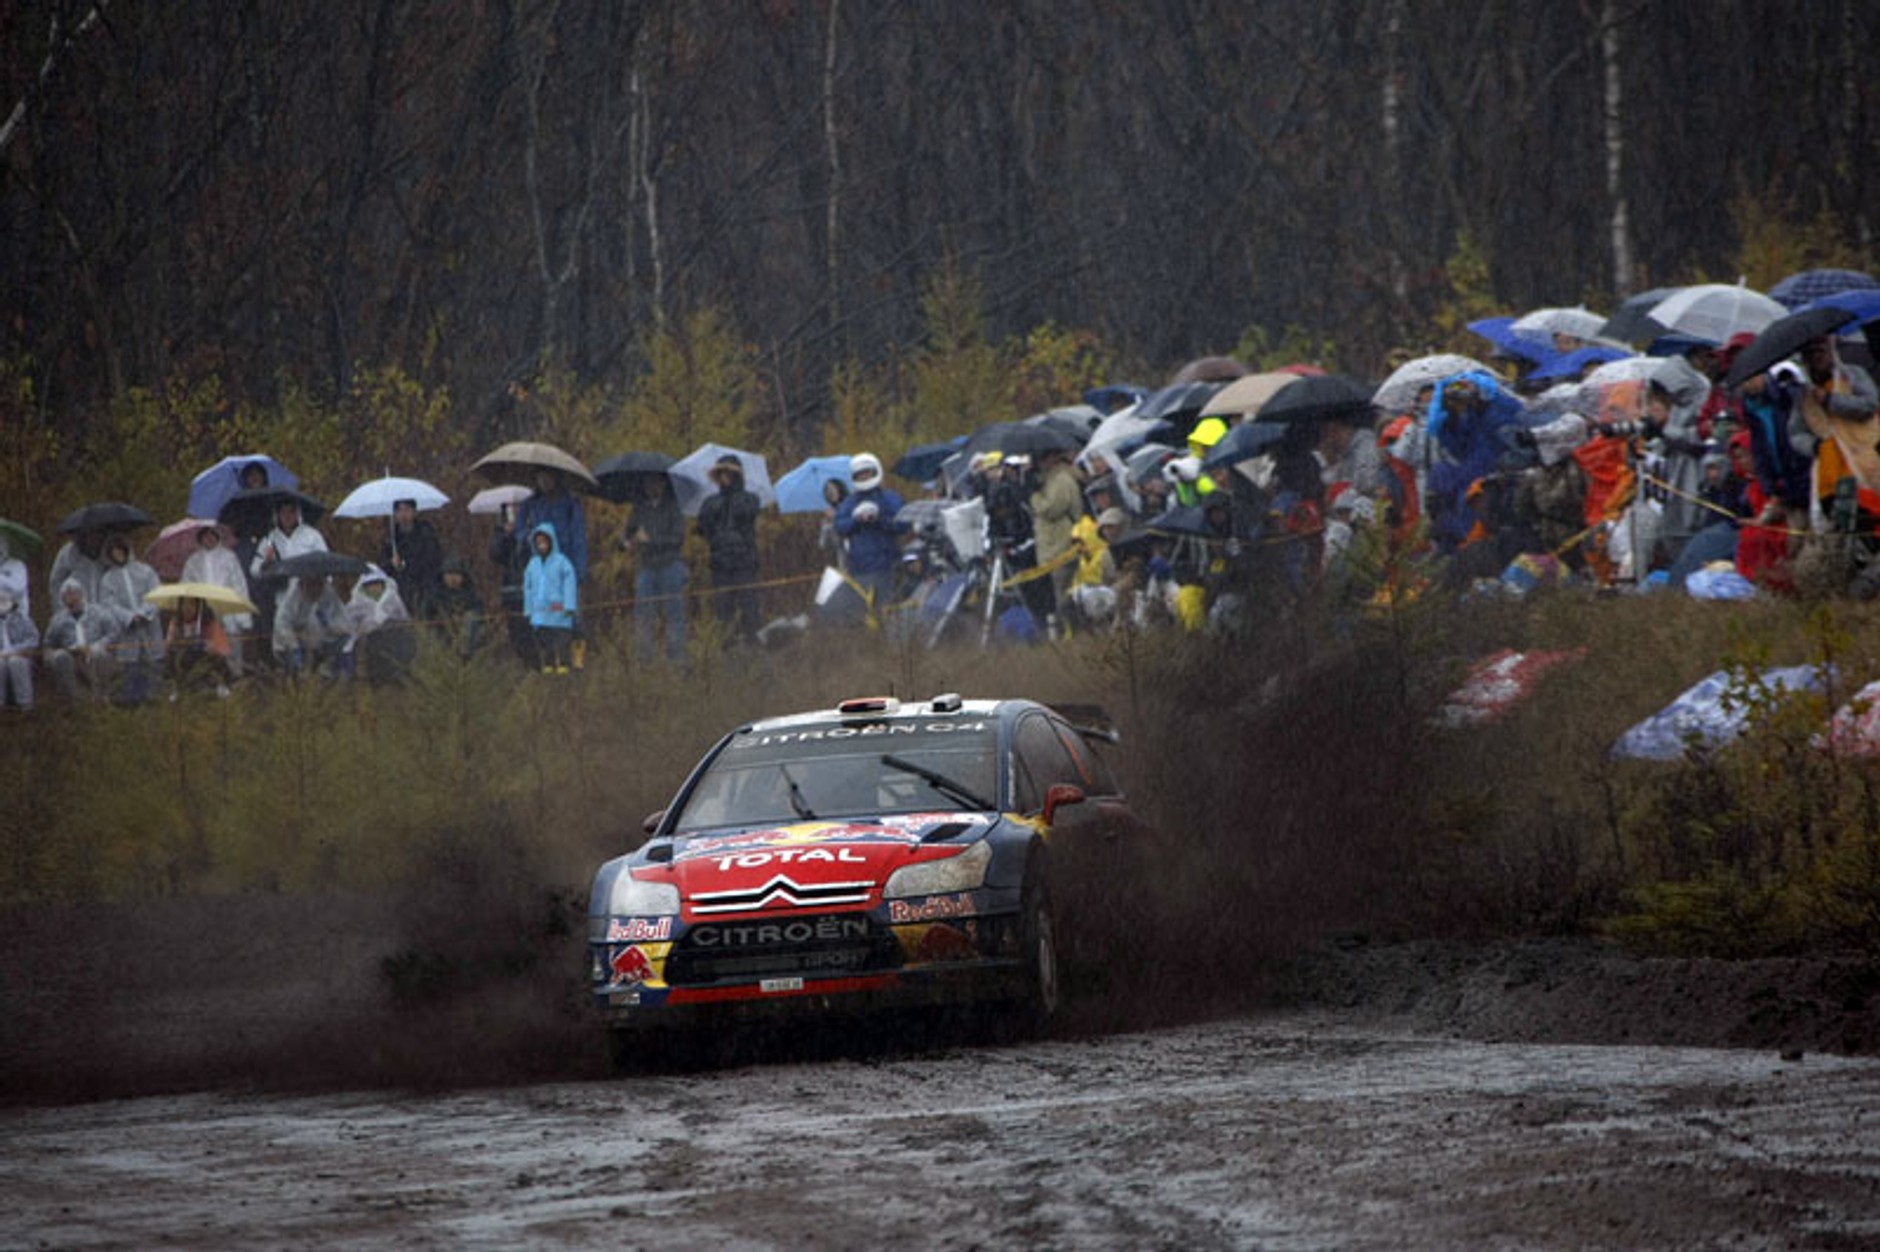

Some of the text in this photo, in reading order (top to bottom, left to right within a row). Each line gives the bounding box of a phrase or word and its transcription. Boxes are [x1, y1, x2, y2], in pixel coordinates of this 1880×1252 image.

[924, 722, 986, 732] C4
[713, 848, 866, 871] TOTAL
[889, 898, 937, 922] Red
[634, 916, 673, 940] Bull
[692, 915, 868, 946] CITROËN
